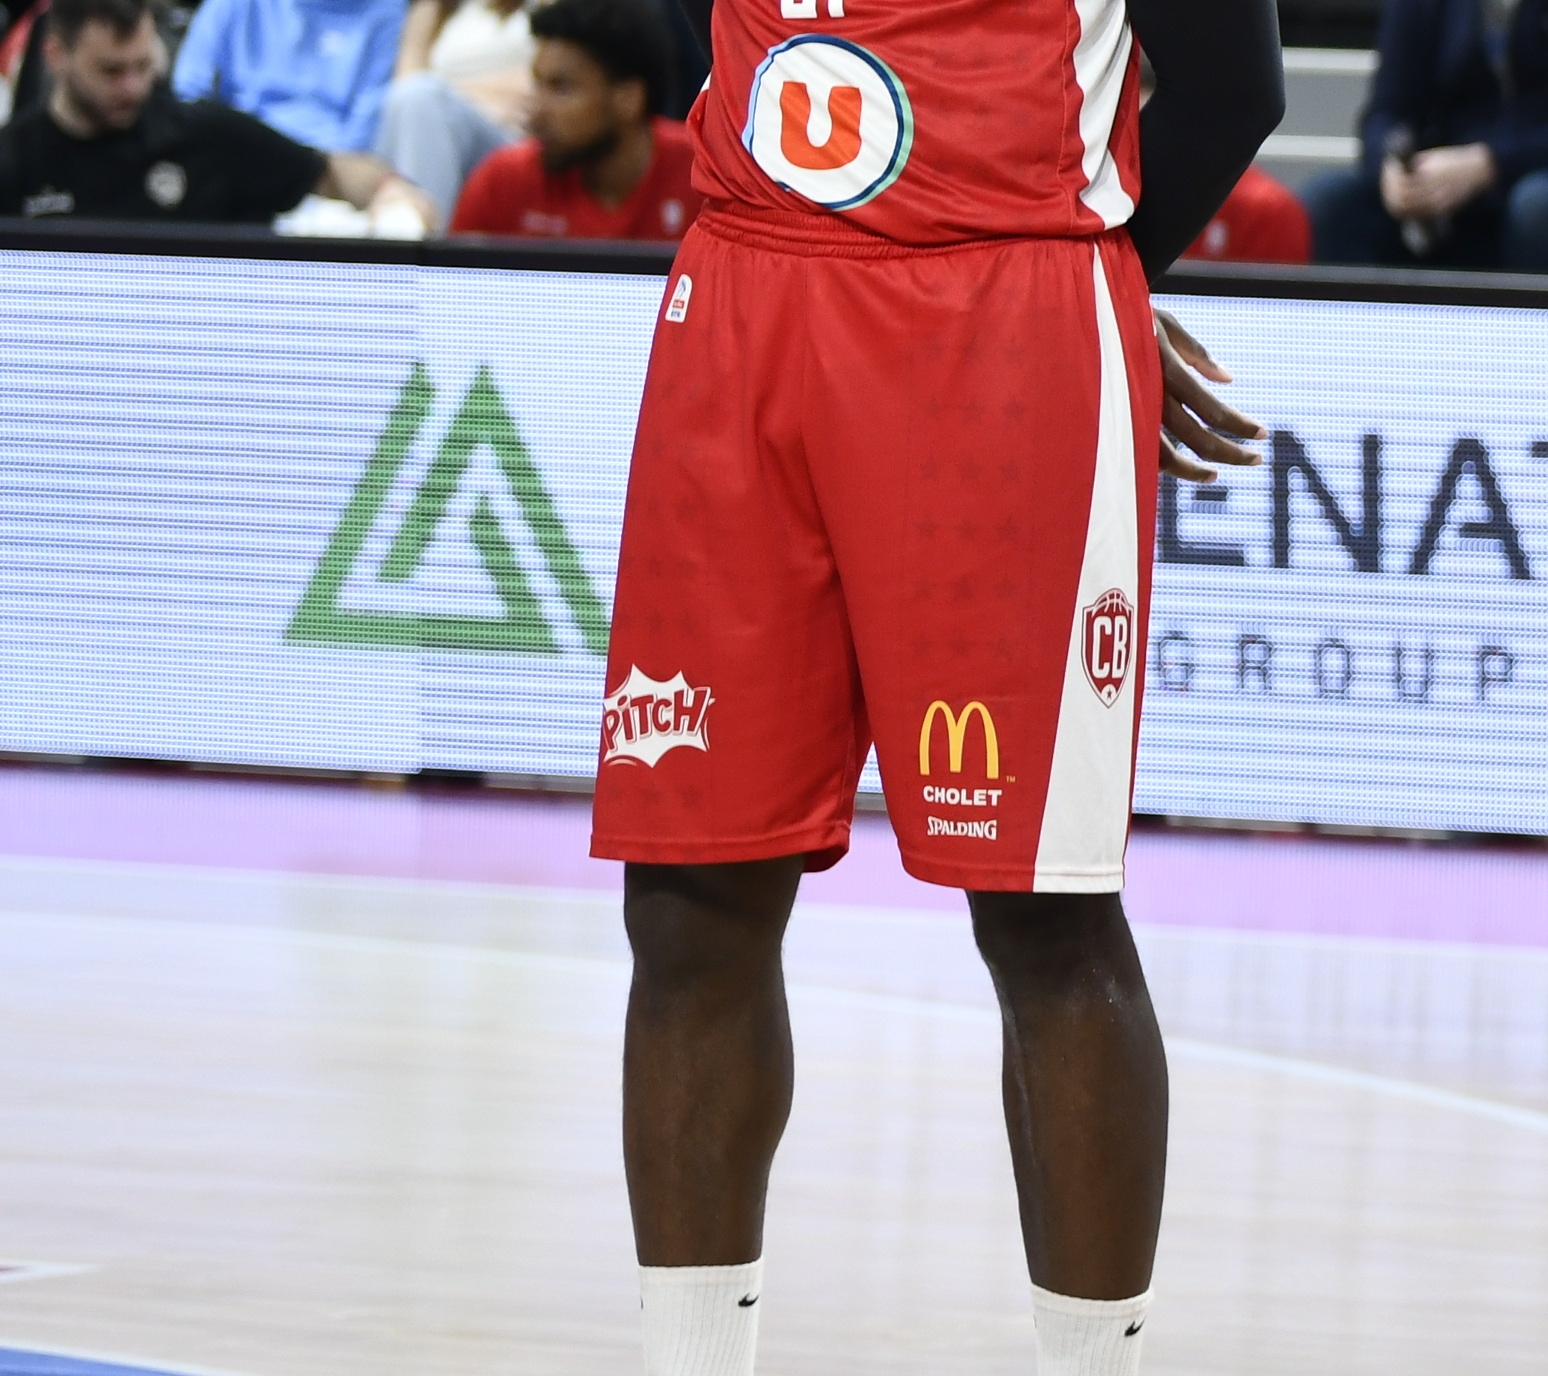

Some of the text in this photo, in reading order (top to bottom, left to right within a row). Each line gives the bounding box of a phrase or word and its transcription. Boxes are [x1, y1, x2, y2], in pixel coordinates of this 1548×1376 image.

[1090, 614, 1130, 679] CB
[922, 785, 1003, 807] CHOLET
[926, 815, 997, 841] SPALDING
